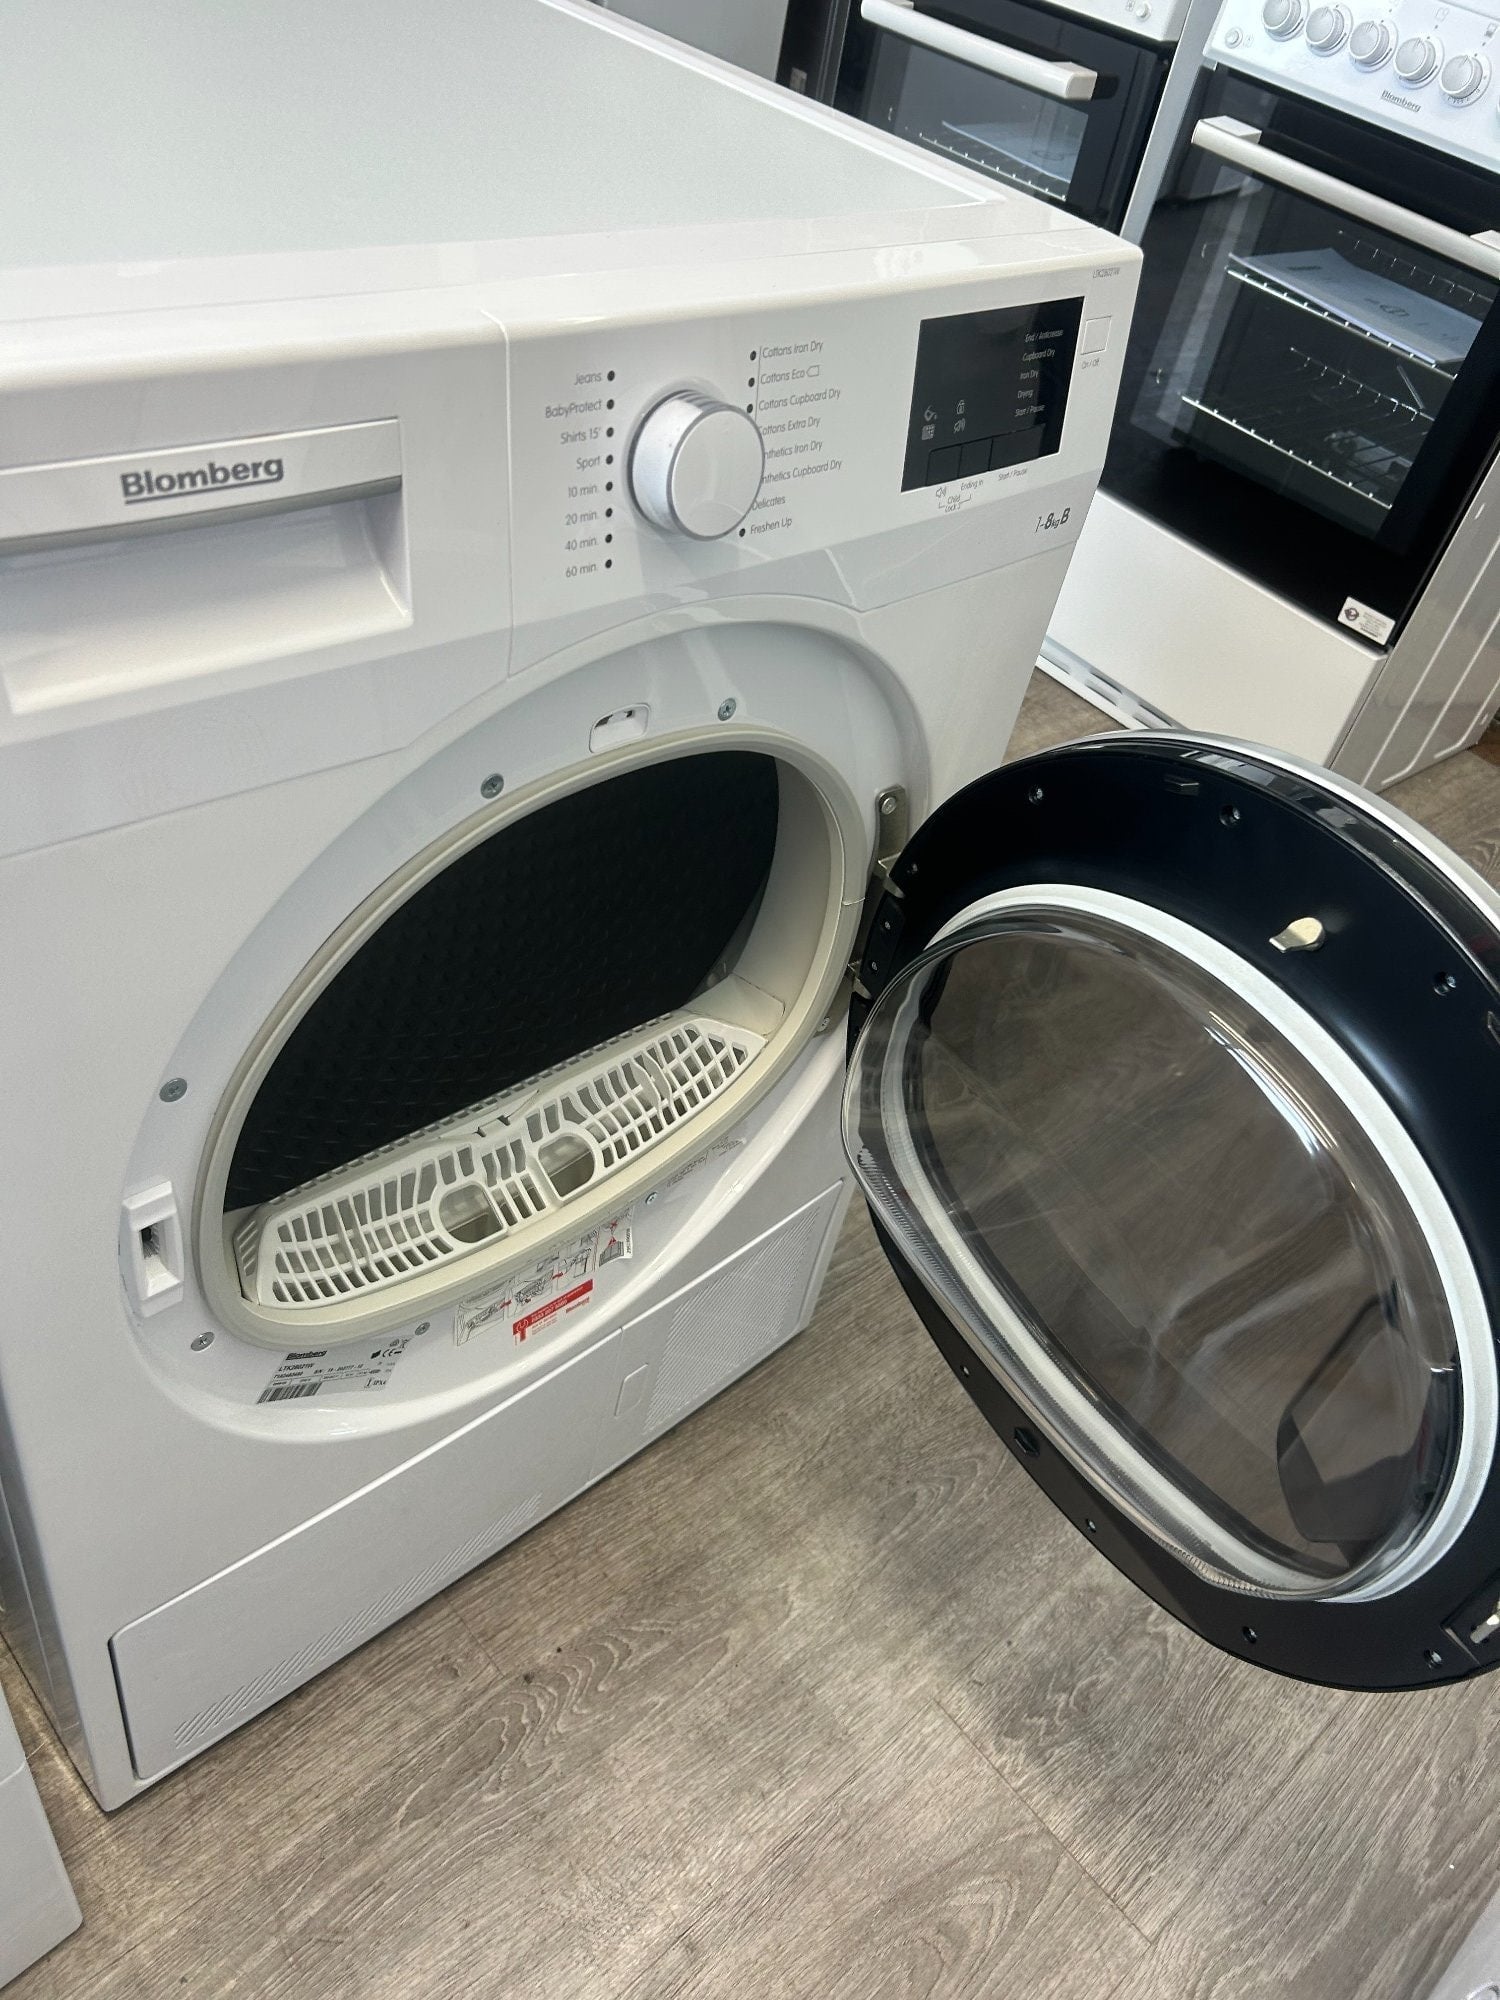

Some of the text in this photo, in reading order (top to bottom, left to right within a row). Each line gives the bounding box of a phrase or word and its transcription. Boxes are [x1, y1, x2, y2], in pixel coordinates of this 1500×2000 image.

[762, 341, 824, 358] Cottons Iron Dry
[574, 372, 602, 386] Jeans
[760, 369, 805, 385] Cottons Eco
[758, 388, 841, 411] Cottons Cupboard Dry
[545, 399, 602, 418] BabyProtect
[788, 419, 807, 431] Extra
[808, 416, 822, 428] Dry
[560, 431, 587, 445] Shirts
[795, 443, 809, 454] Iron
[811, 440, 823, 452] Dry
[576, 456, 601, 472] Sport
[792, 463, 829, 479] Cupboard
[830, 459, 843, 471] Dry
[121, 458, 284, 505] Blomberg
[568, 486, 578, 498] 10
[565, 513, 577, 526] 20
[750, 517, 792, 534] Freshen Up
[565, 539, 577, 551] 40
[566, 565, 577, 578] 60
